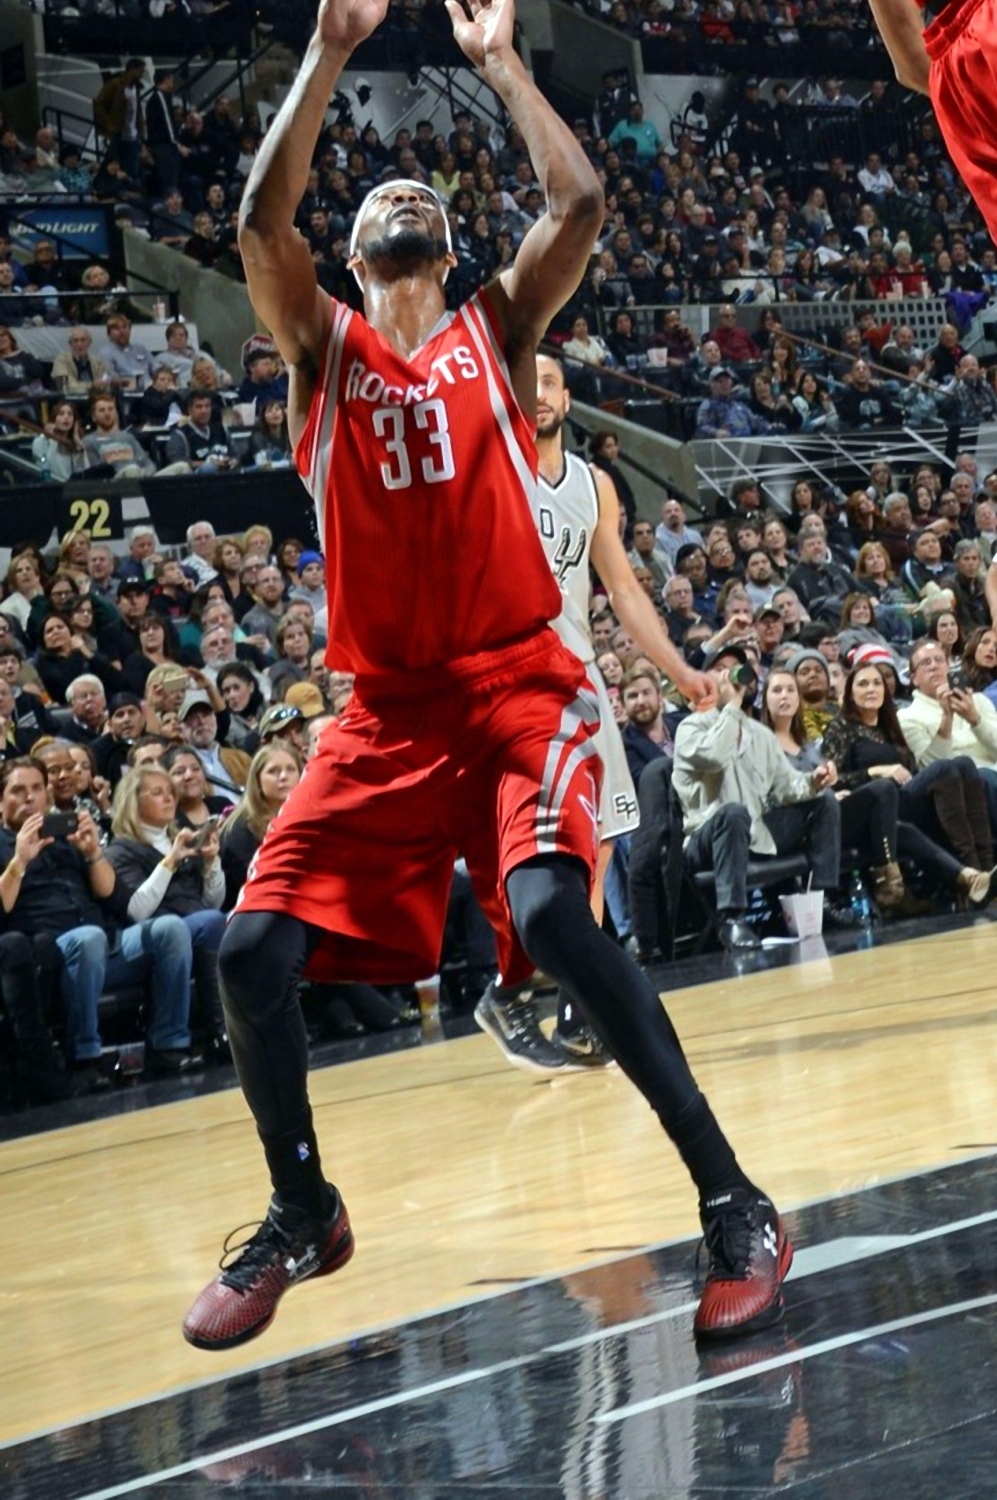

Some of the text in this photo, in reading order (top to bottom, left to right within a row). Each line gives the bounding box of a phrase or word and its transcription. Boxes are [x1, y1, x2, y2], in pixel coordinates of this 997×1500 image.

[52, 221, 99, 234] LIGHT
[372, 398, 455, 490] 33
[70, 499, 111, 537] 22
